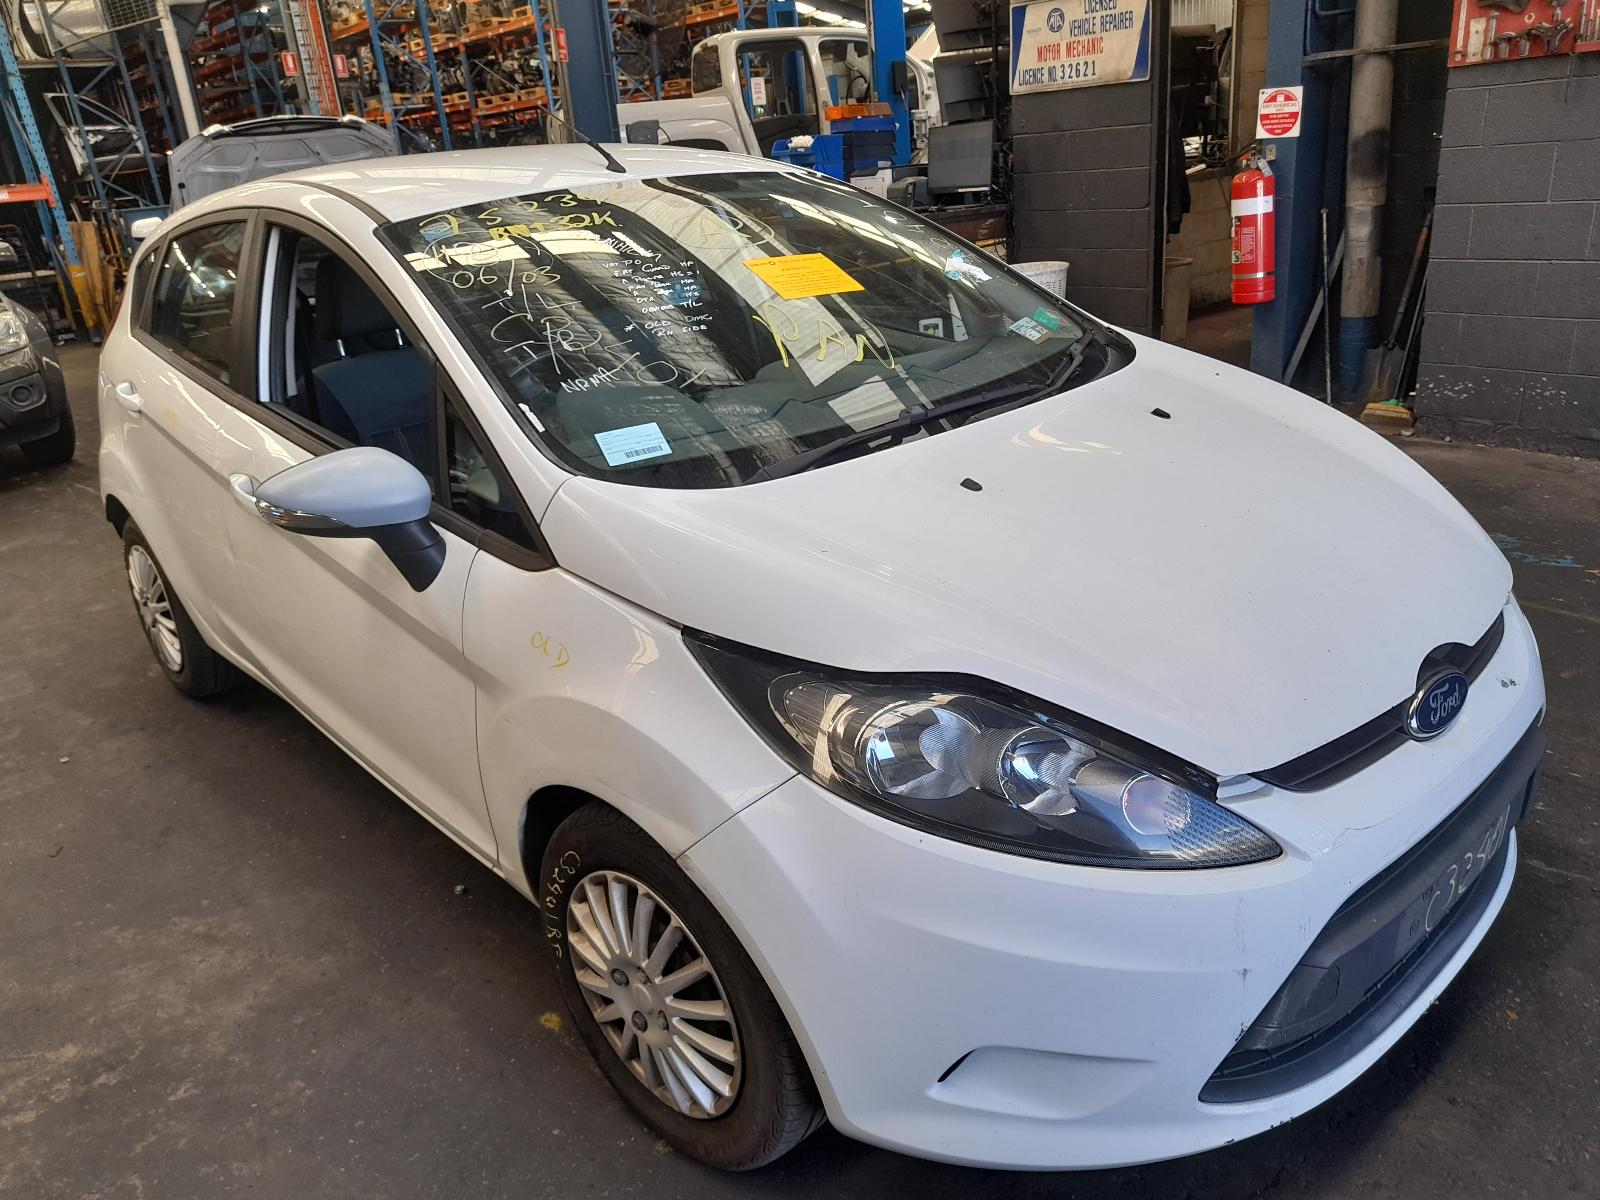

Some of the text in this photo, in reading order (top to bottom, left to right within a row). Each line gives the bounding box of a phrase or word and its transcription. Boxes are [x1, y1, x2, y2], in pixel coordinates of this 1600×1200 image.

[1069, 10, 1134, 37] VEHICLE REPAIRER
[1037, 37, 1104, 62] MOTOR MECHANIC
[1018, 67, 1045, 86] LICENCE
[1060, 60, 1096, 80] 32621
[1429, 682, 1461, 725] Ford
